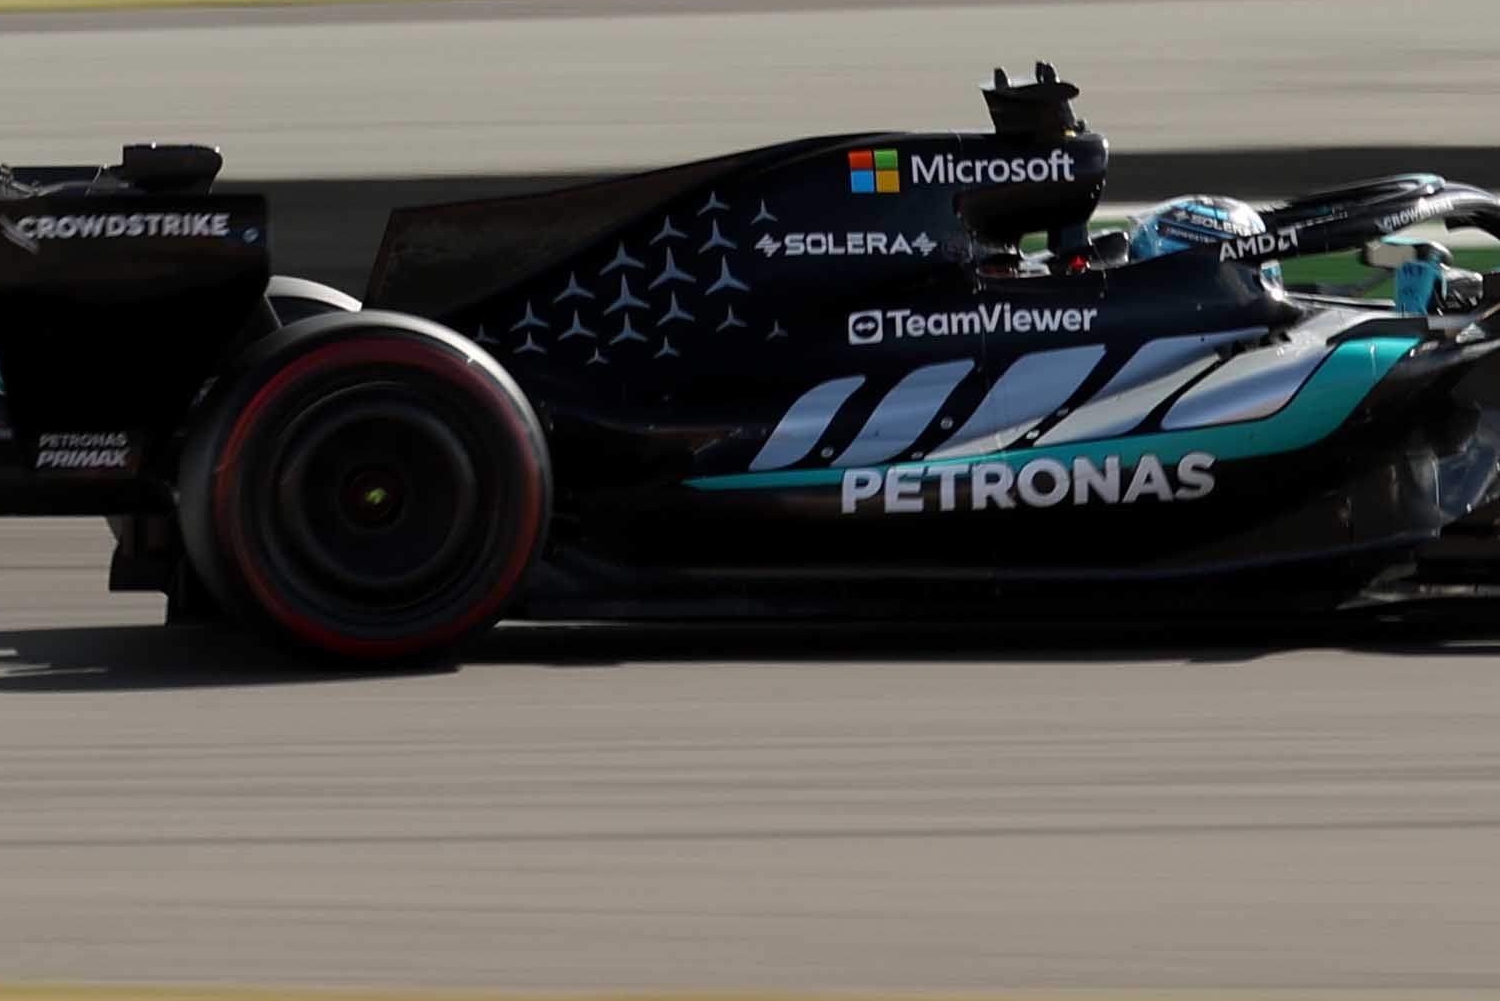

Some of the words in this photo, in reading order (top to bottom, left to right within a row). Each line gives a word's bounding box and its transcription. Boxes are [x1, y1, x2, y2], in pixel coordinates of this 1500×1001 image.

[911, 149, 1075, 185] Microsoft
[16, 212, 230, 239] CROWDSTRIKE
[783, 232, 913, 256] SOLERA
[1219, 233, 1276, 262] AMD
[886, 302, 1098, 338] TeamViewer
[39, 433, 128, 448] PETRONAS
[35, 448, 131, 468] PRIMAX
[841, 451, 1216, 515] PETRONAS
